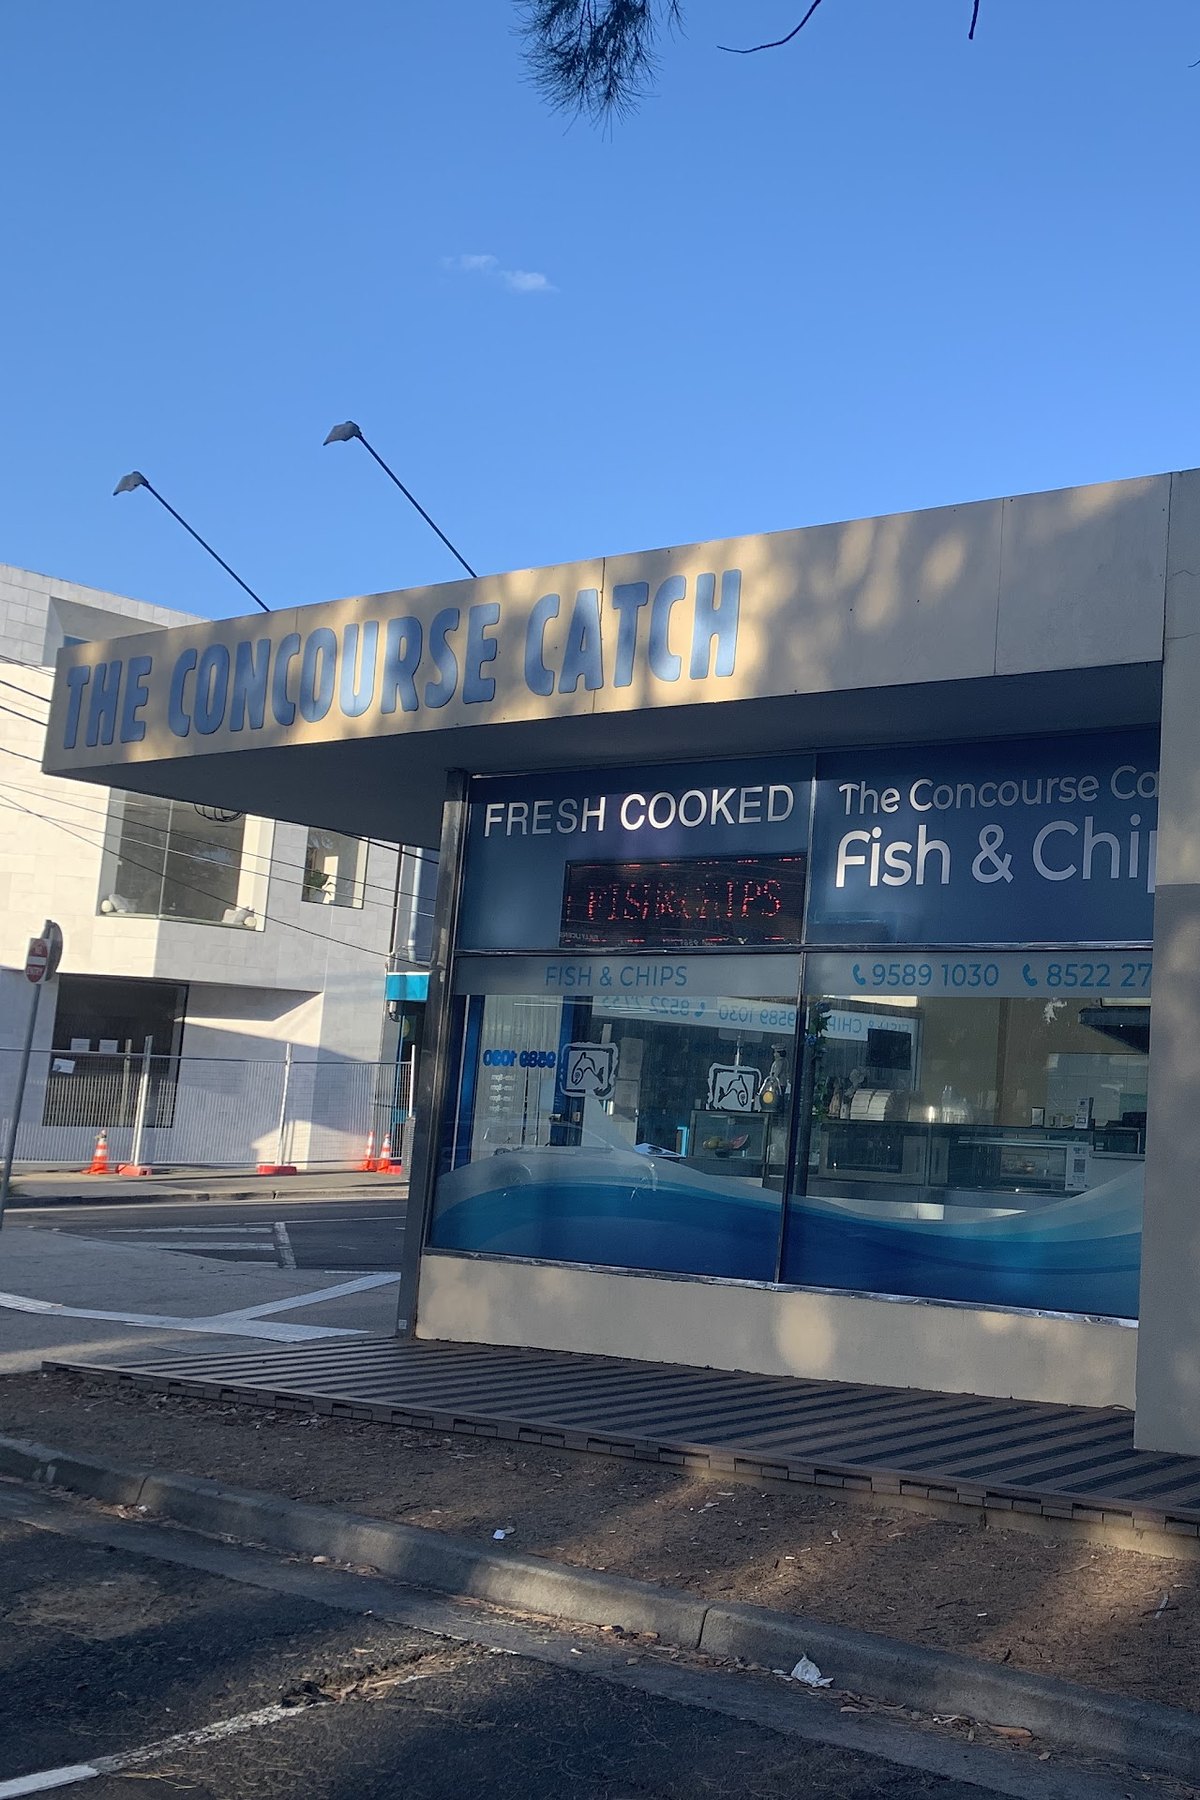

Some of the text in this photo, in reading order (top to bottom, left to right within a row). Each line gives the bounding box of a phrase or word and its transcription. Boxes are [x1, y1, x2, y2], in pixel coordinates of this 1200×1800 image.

[64, 569, 742, 749] THE CONCOURSE CATCH
[484, 785, 794, 837] FRESH COOKED
[838, 778, 900, 815] The
[910, 774, 1099, 812] Concourse
[836, 824, 950, 888] Fish
[971, 824, 1014, 884] &
[545, 965, 688, 987] FISH & CHIPS
[871, 963, 999, 987] 9589 1030
[1046, 963, 1111, 987] 8522
